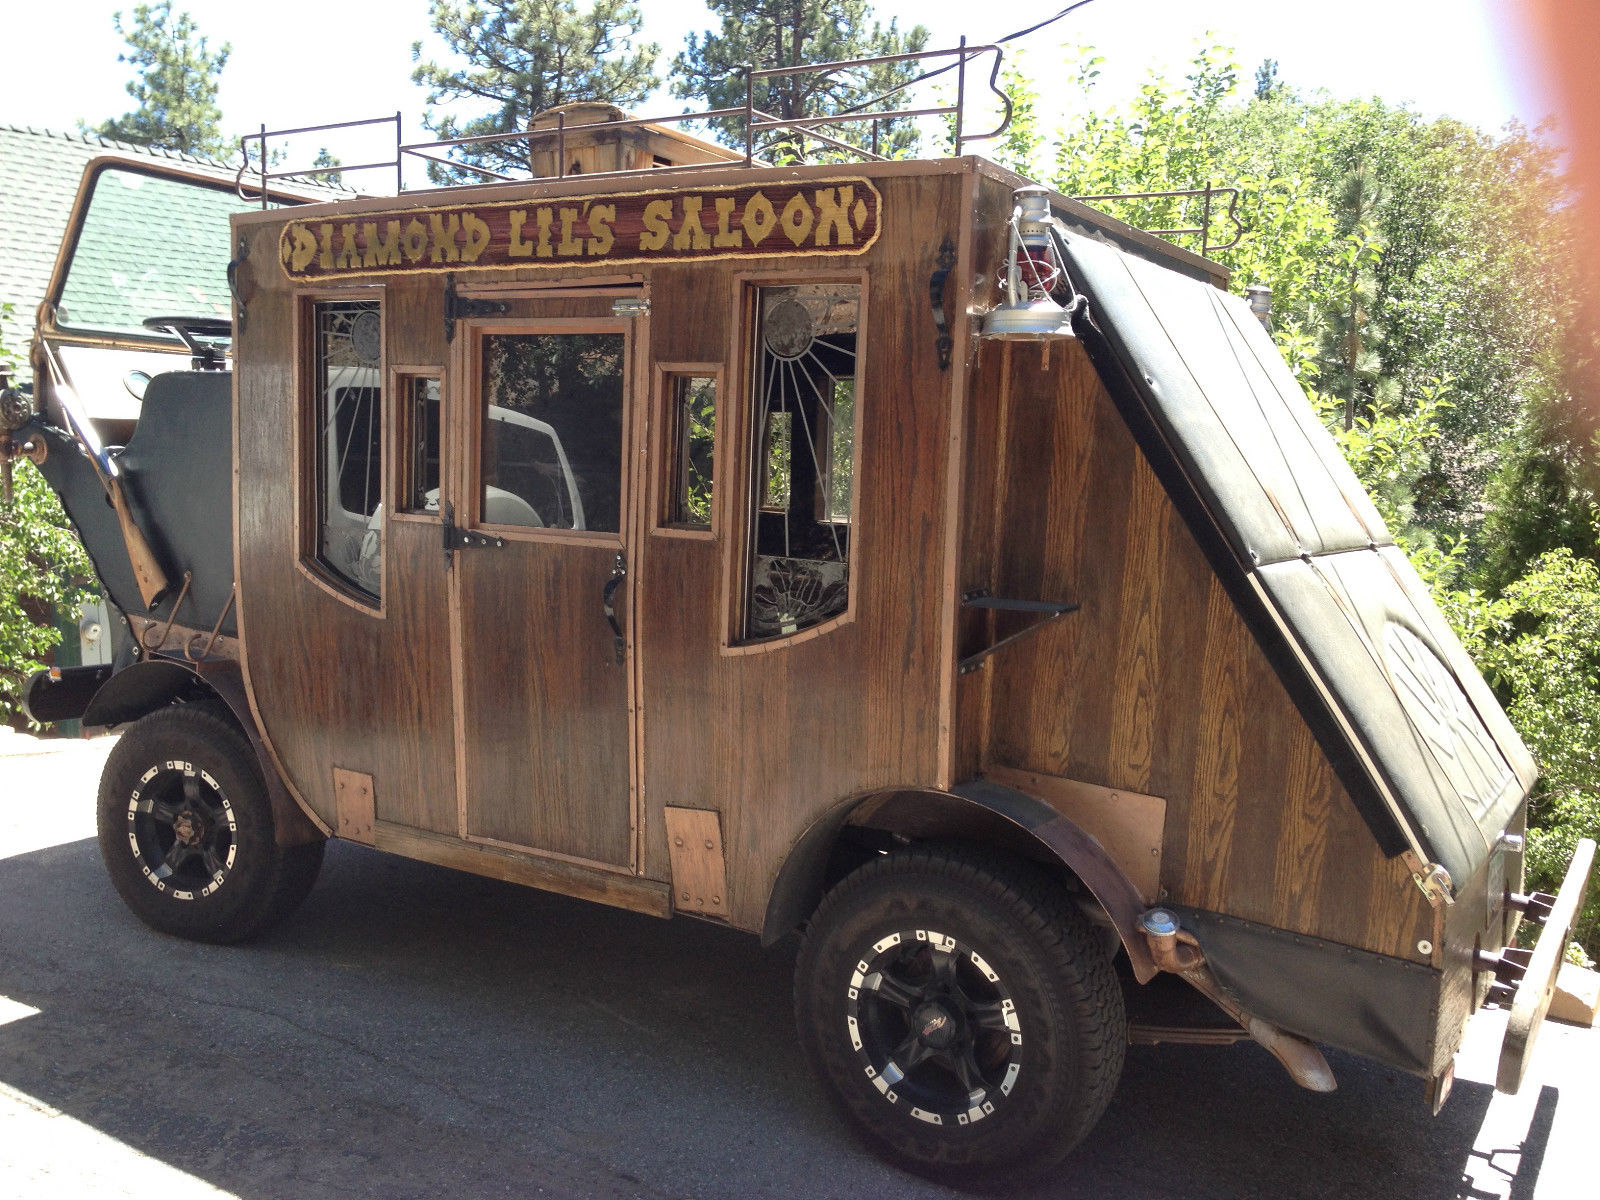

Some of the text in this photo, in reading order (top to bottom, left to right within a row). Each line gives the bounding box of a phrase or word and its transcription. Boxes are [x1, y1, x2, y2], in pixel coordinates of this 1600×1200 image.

[292, 186, 855, 271] DIAMOND LIL'S SALOON
